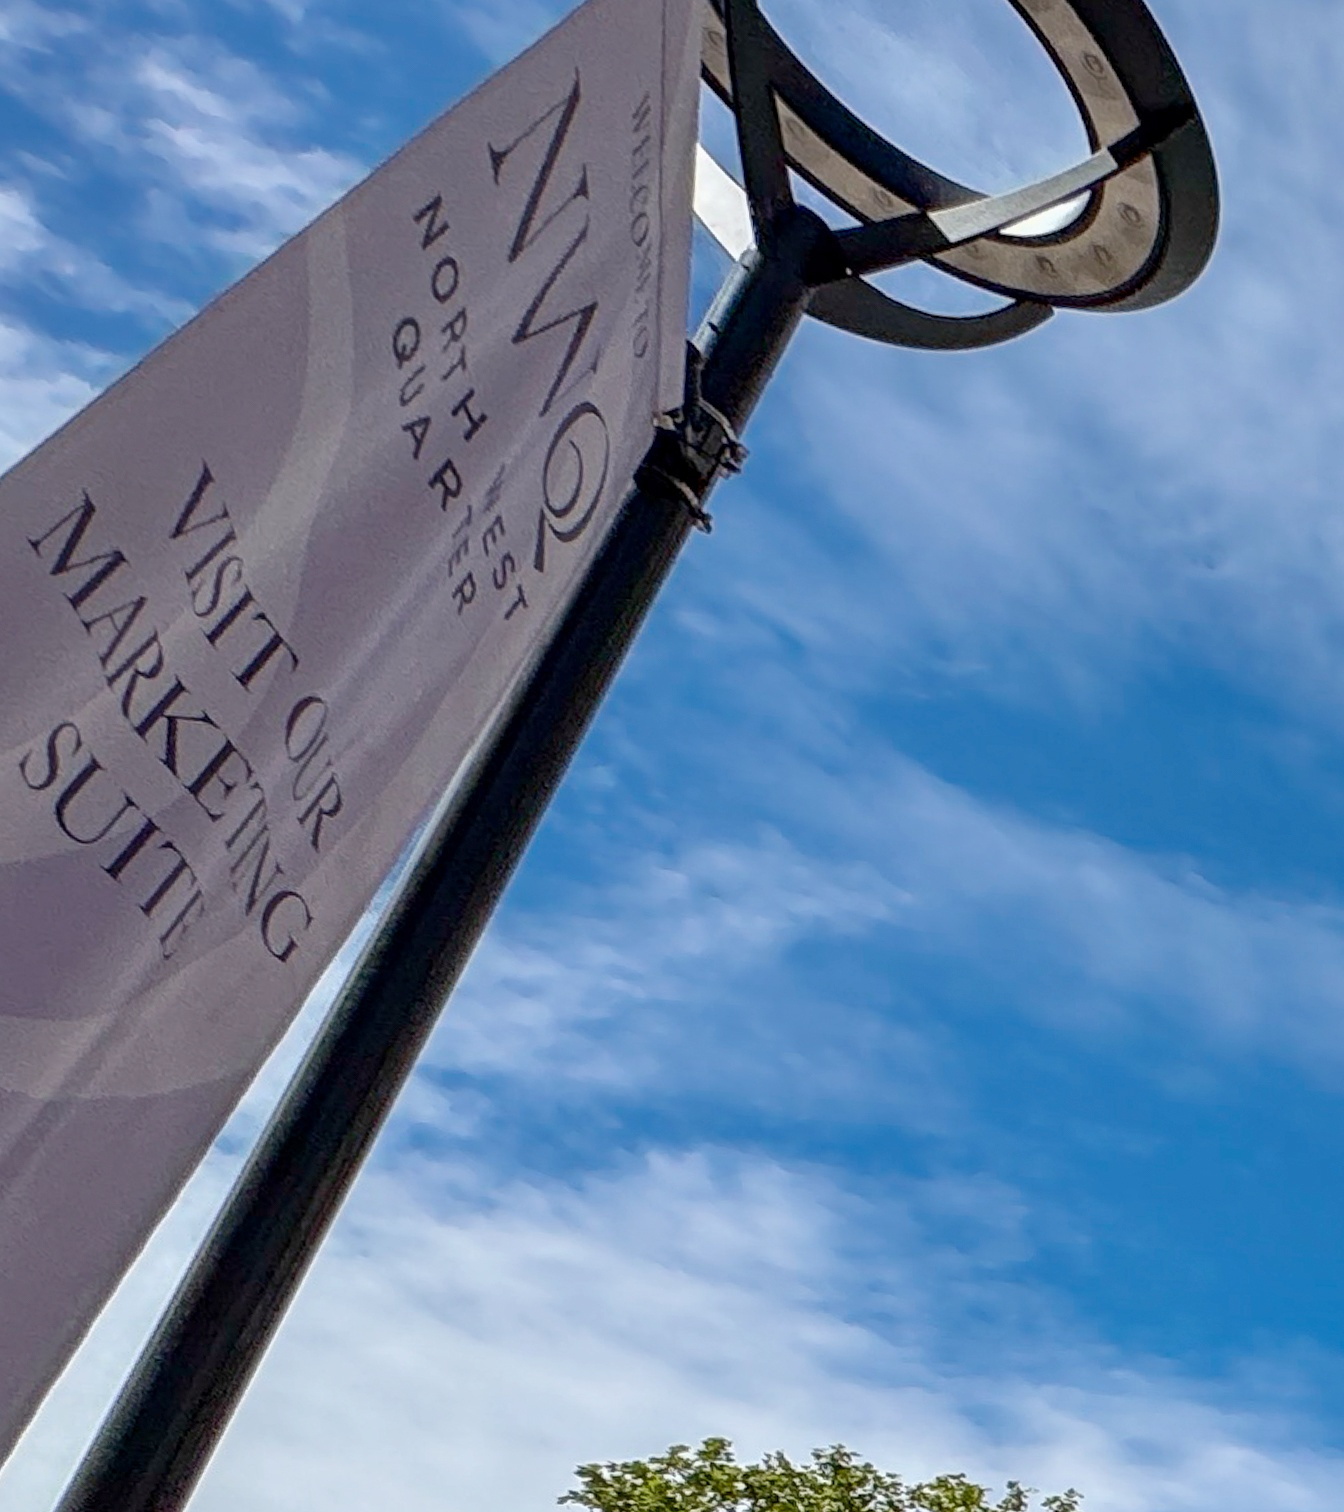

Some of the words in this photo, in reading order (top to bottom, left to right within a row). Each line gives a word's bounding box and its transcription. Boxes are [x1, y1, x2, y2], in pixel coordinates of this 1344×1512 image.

[393, 316, 478, 616] QUARTER
[413, 195, 488, 442] NORTH
[488, 66, 609, 573] NWQ
[26, 487, 314, 963] MARKETING
[168, 458, 299, 693] VISIT
[285, 695, 342, 852] OUR
